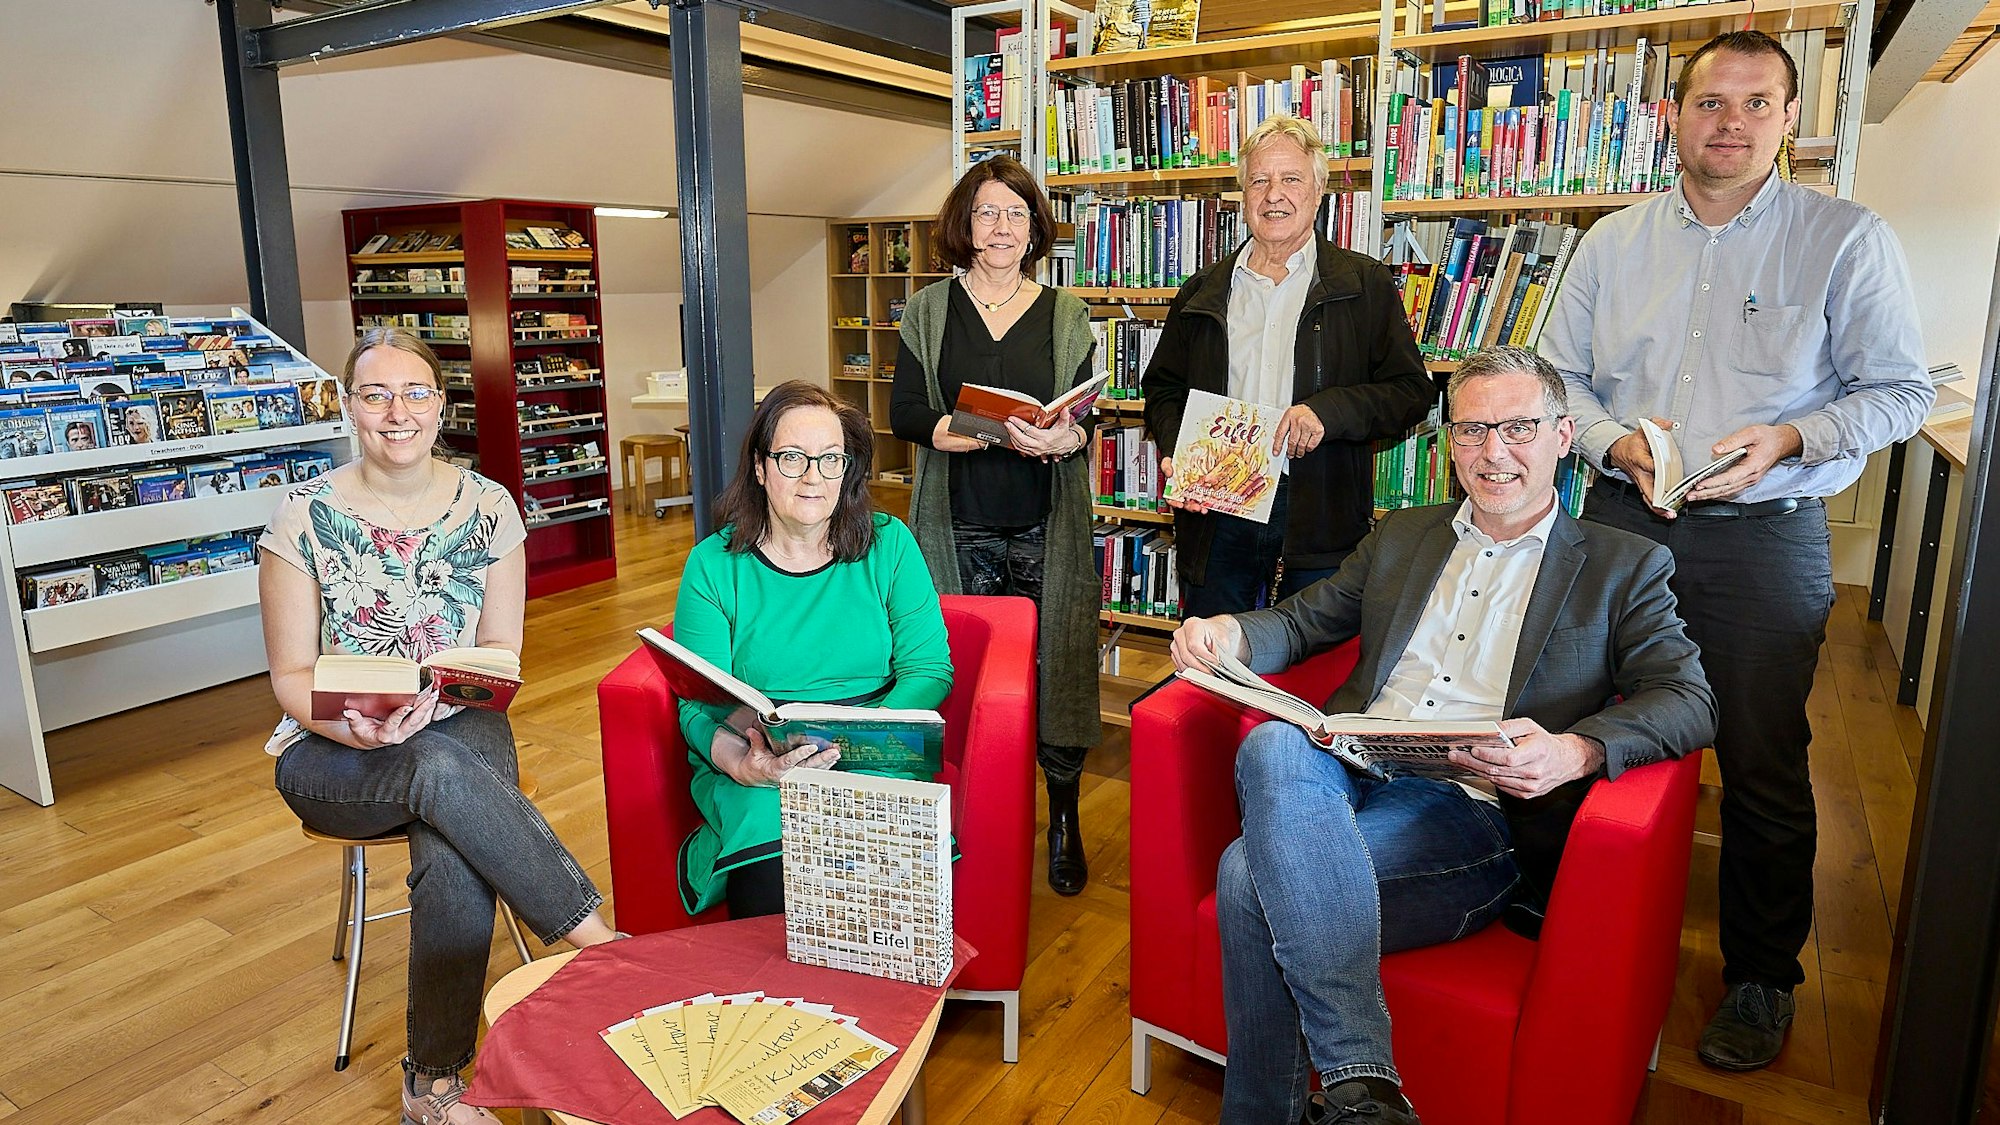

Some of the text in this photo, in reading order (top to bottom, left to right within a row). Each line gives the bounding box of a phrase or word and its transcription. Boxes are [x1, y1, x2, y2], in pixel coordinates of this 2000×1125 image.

[168, 427, 205, 436] ARTHUR
[1209, 416, 1261, 445] Eifel
[112, 434, 130, 446] JOY
[151, 446, 185, 455] Erwachsenen
[899, 816, 910, 826] in
[799, 865, 816, 874] der
[873, 931, 910, 950] Eifel
[766, 1037, 841, 1085] Kultour
